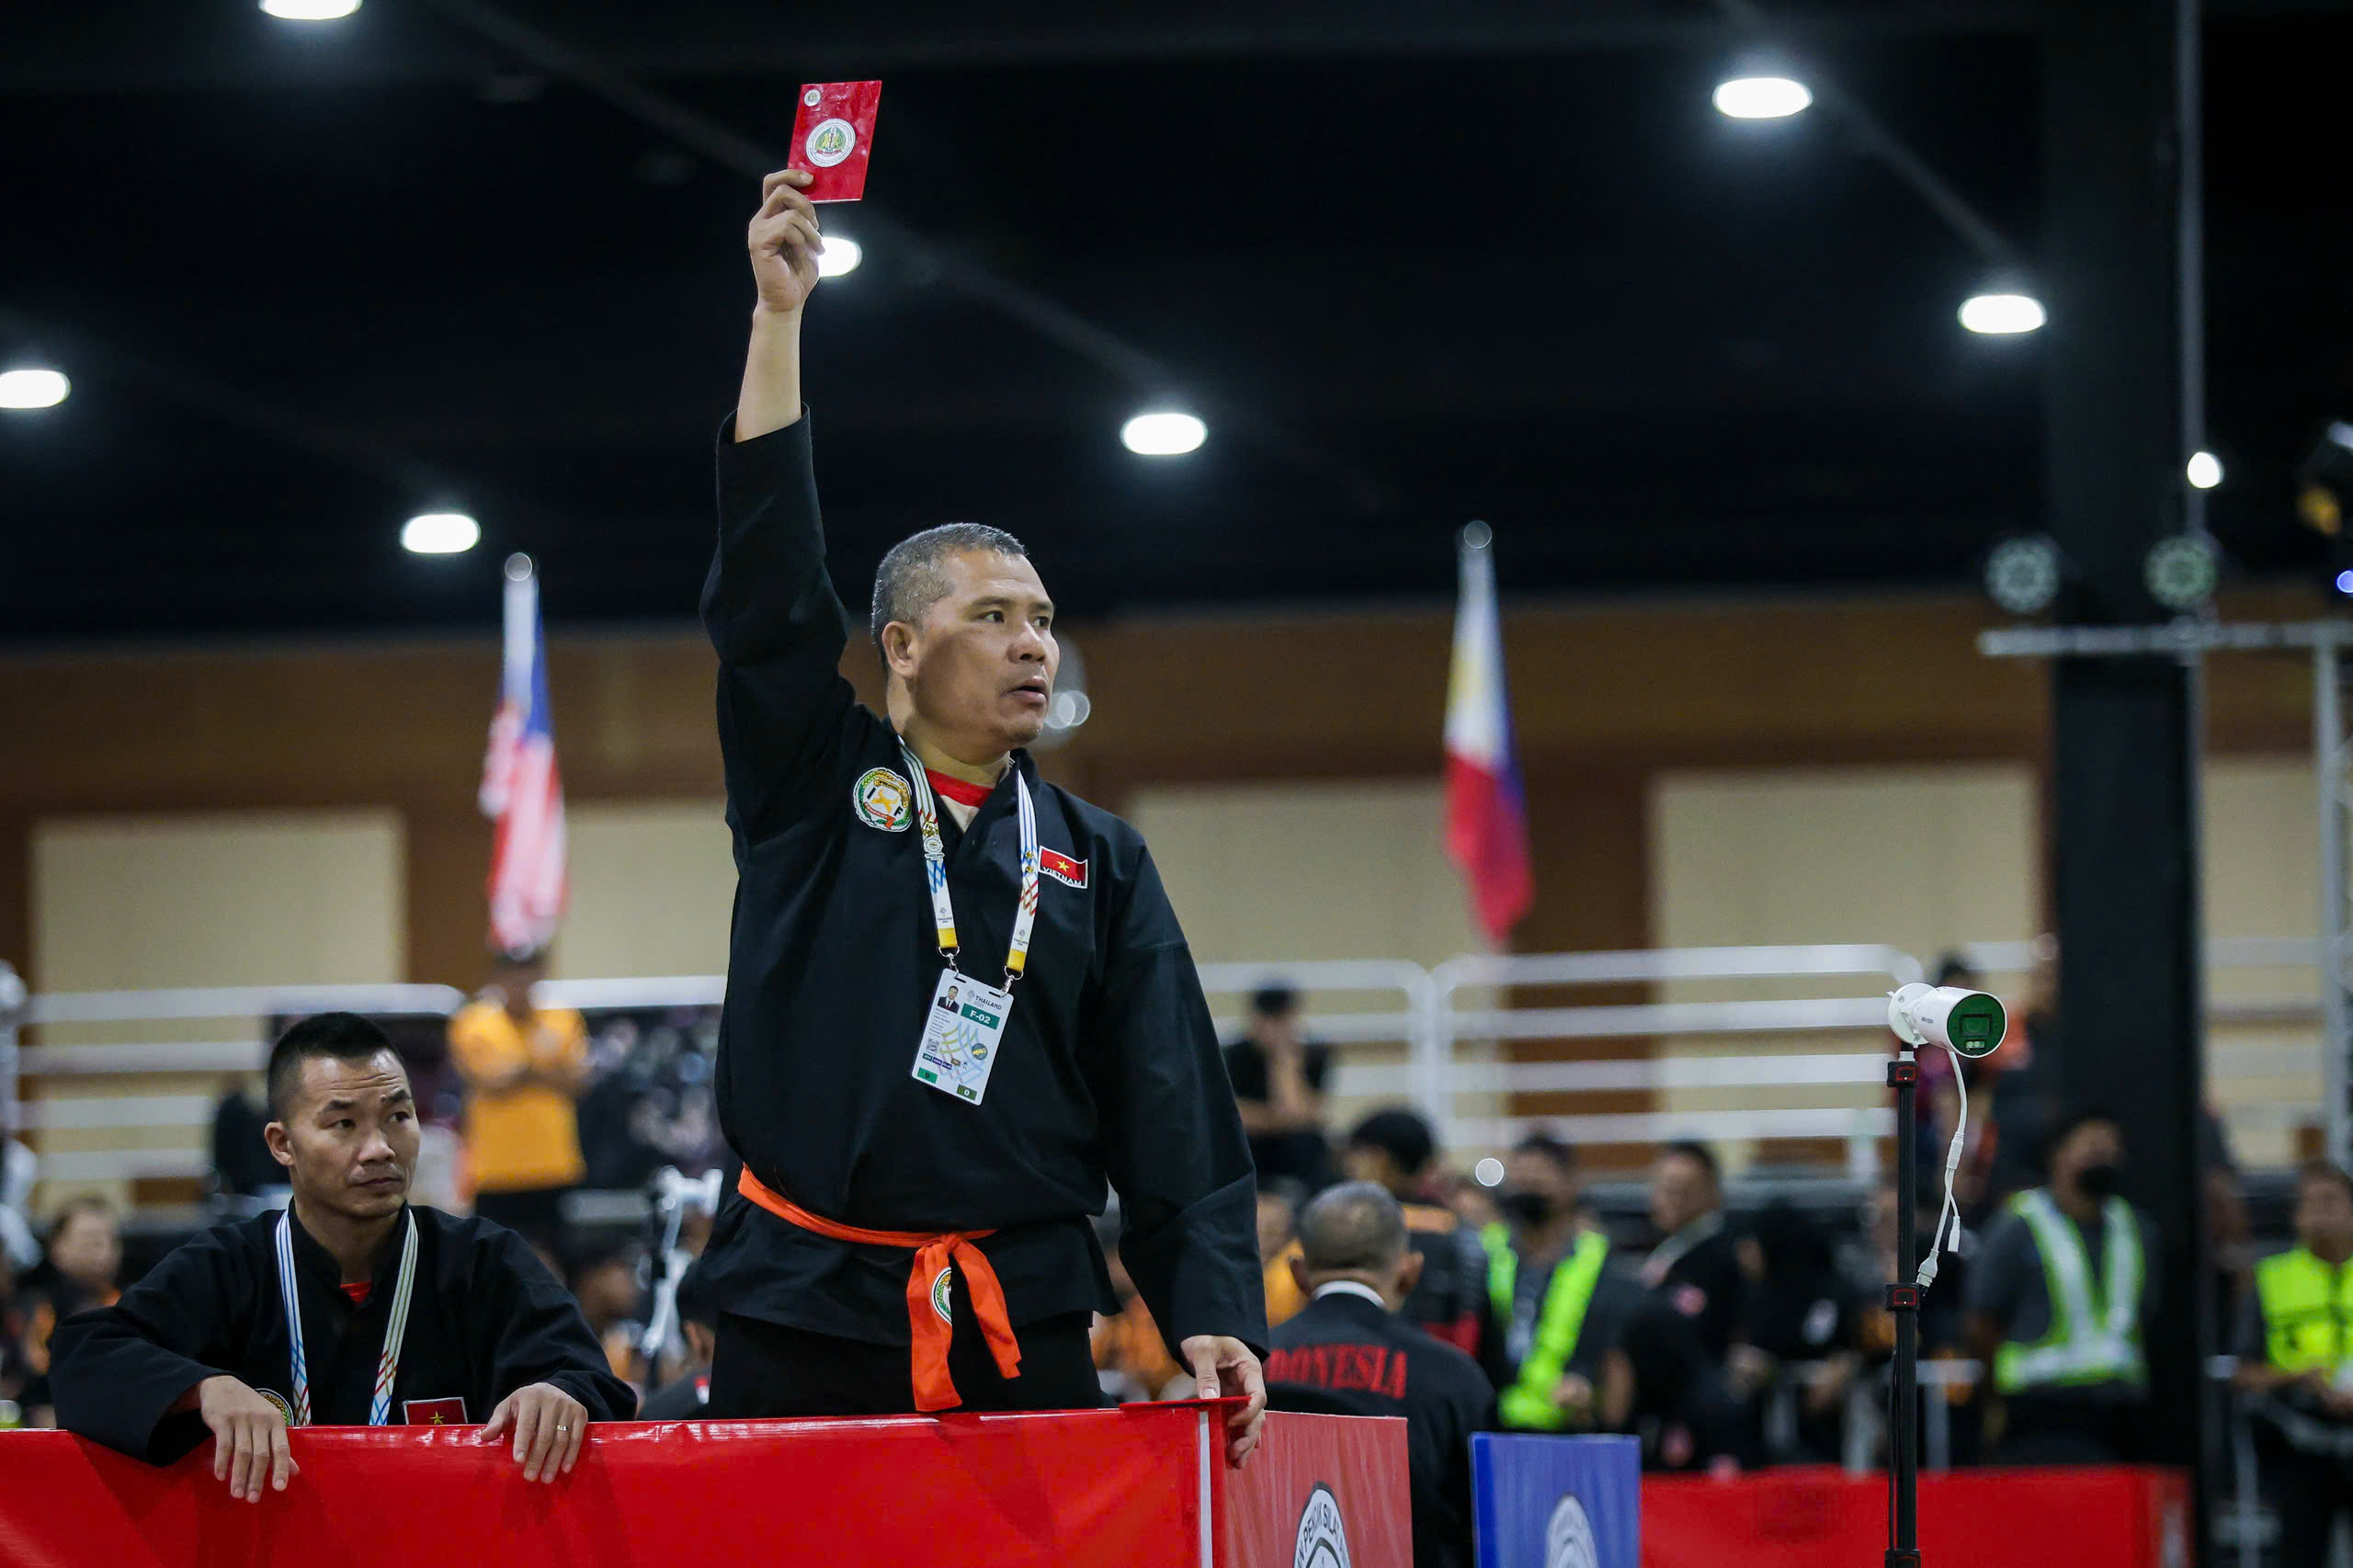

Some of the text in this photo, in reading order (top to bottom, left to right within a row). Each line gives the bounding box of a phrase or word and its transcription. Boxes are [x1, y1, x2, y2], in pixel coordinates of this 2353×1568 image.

[1042, 866, 1082, 886] VIETNAM
[975, 995, 1003, 1009] THAILAND
[970, 1009, 991, 1024] F-02
[1264, 1343, 1407, 1400] DONESIA
